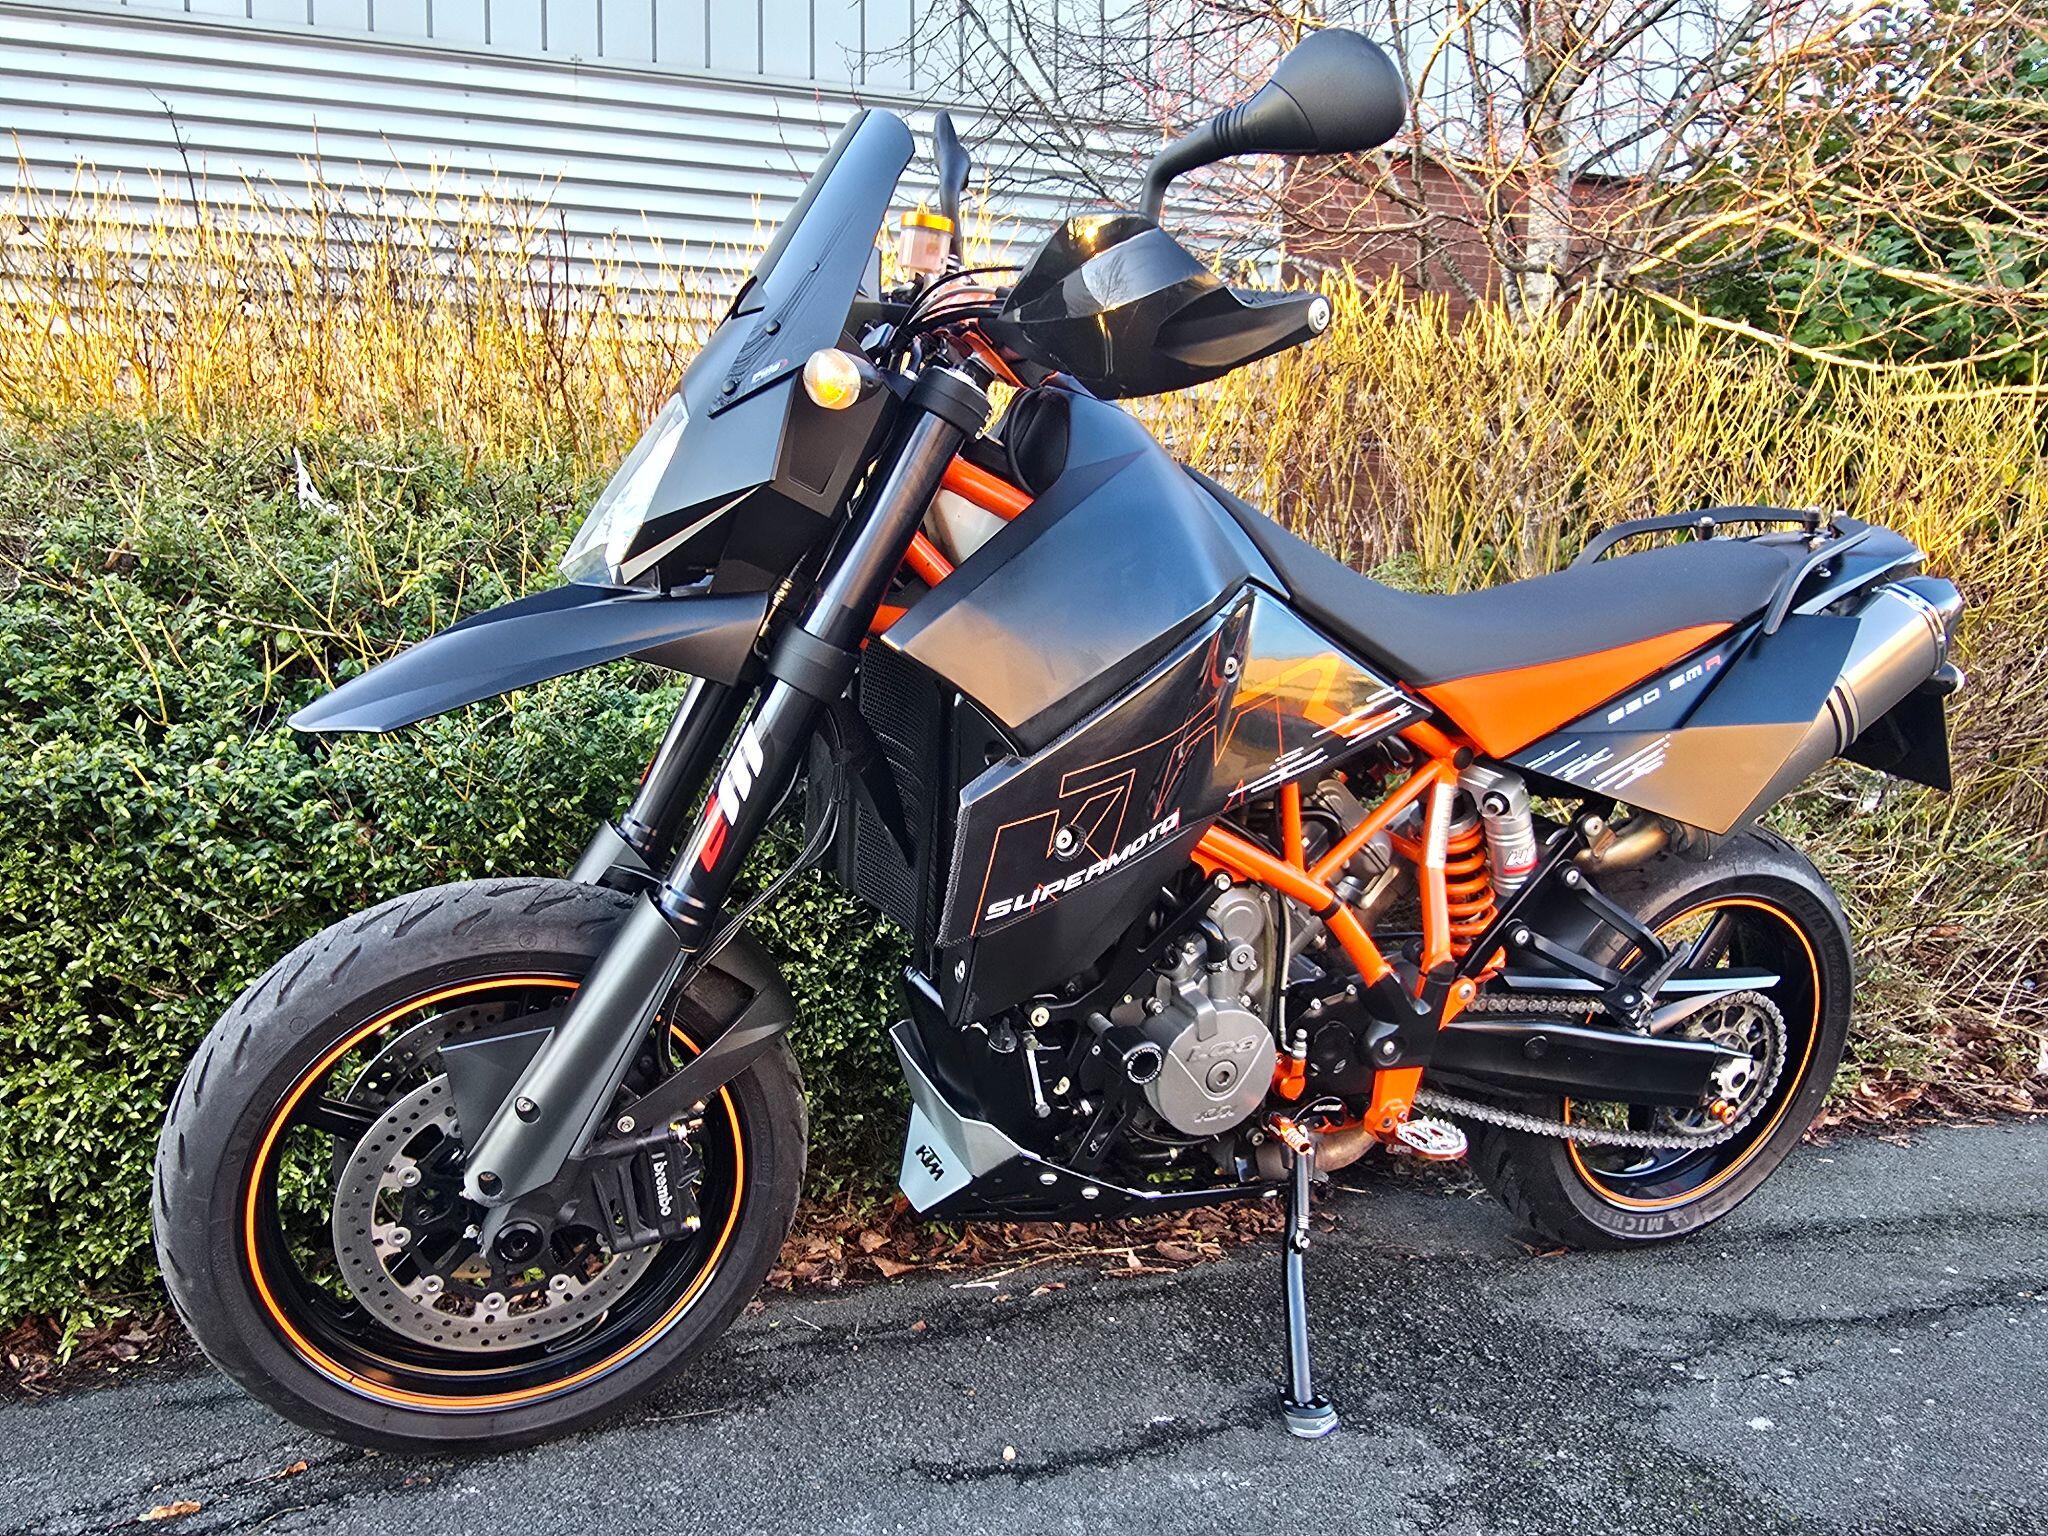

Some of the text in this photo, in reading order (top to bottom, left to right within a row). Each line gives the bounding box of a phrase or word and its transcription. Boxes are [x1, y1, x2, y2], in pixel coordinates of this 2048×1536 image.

[984, 810, 1181, 921] SUPERMOTO
[652, 1160, 674, 1217] brembo
[914, 1144, 945, 1182] KTM
